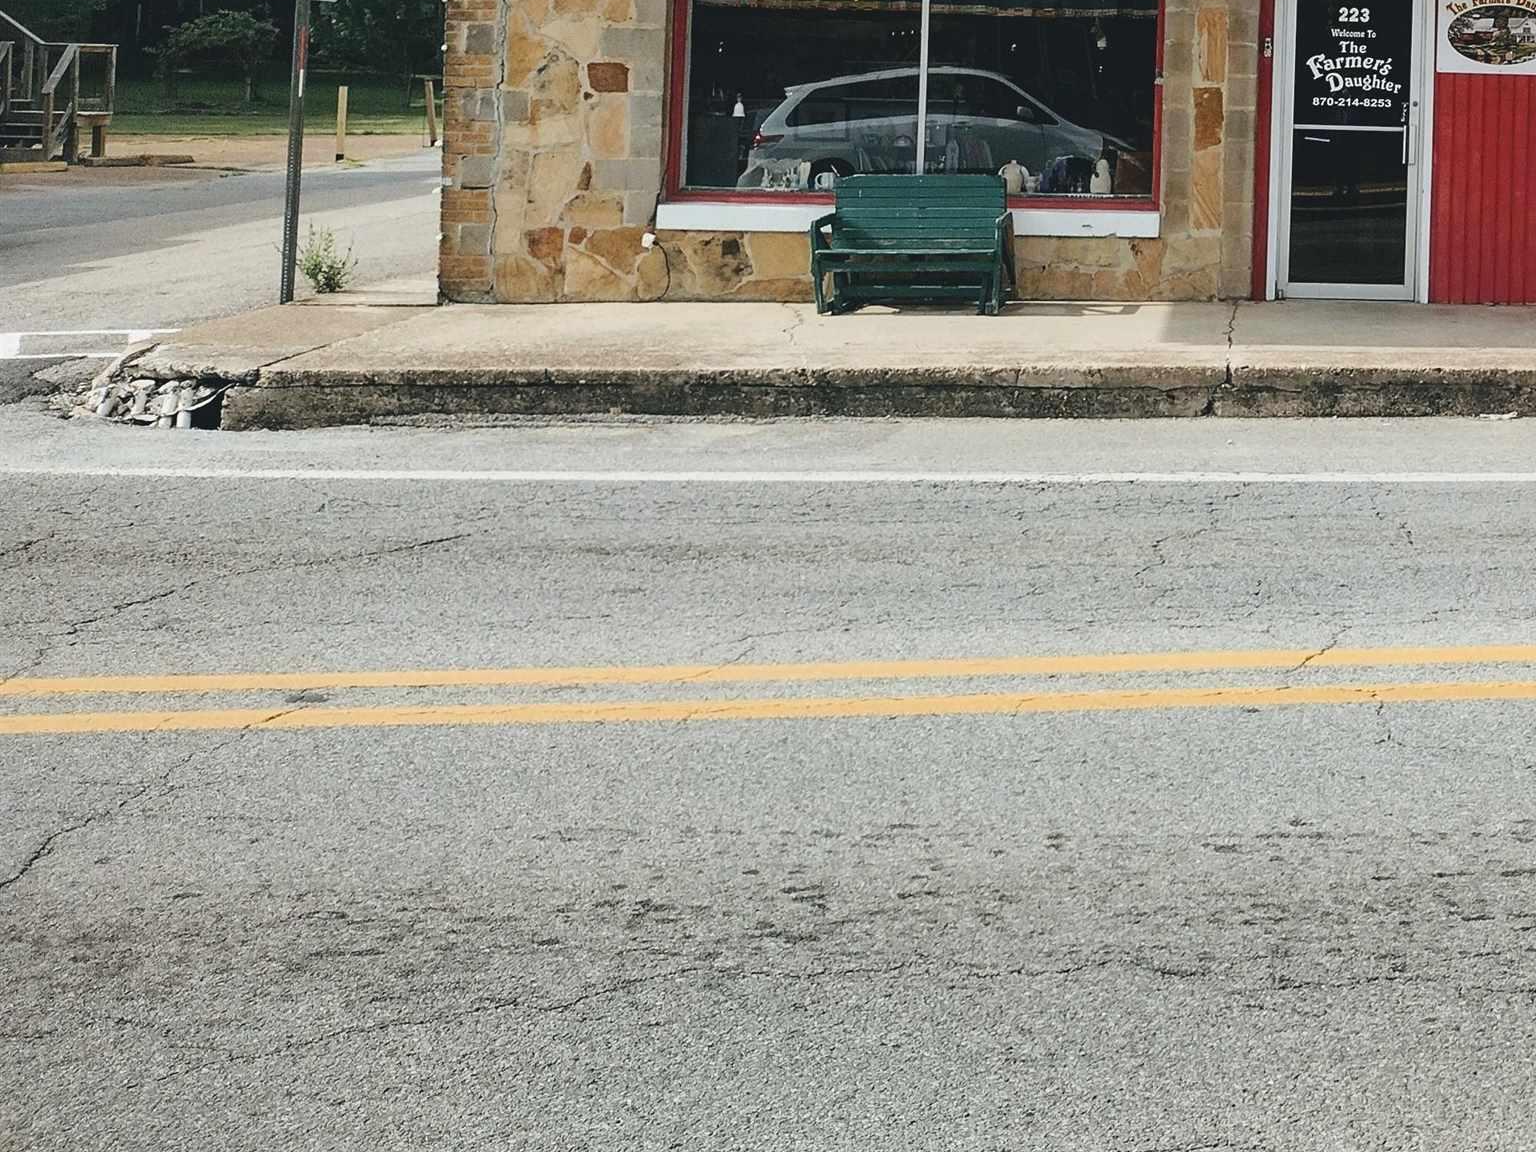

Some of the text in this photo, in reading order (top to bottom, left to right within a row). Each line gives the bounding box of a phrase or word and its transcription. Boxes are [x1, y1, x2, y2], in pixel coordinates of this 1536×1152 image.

[1338, 7, 1370, 23] 223
[1446, 1, 1468, 15] The
[1331, 28, 1376, 38] Welcome To
[1339, 41, 1367, 54] The
[1306, 53, 1393, 80] Farmer's
[1325, 72, 1402, 94] Daughter
[1312, 97, 1392, 108] 870-214-8253
